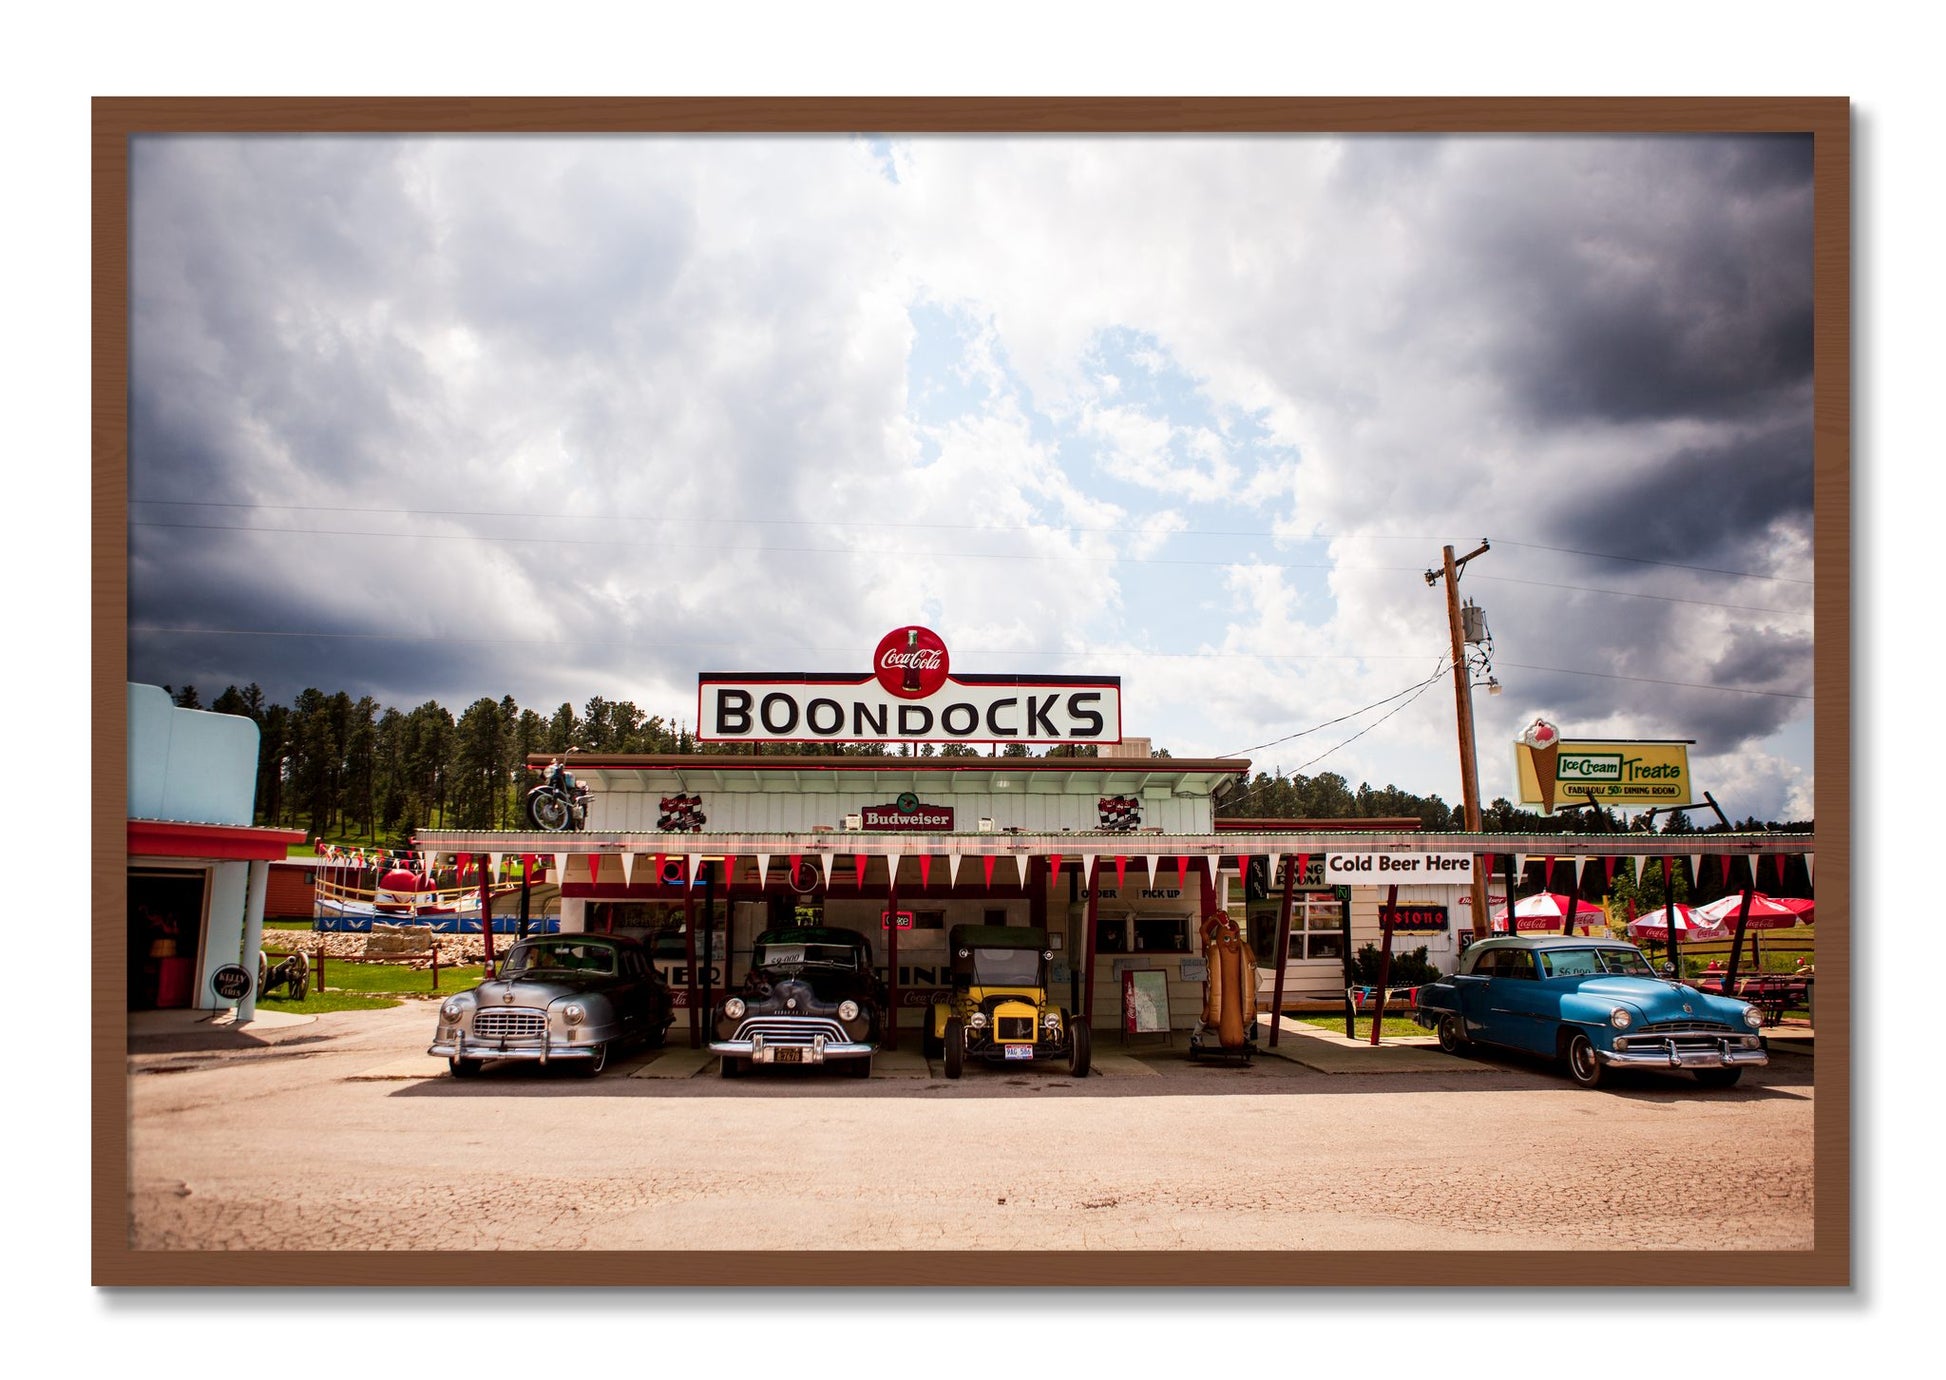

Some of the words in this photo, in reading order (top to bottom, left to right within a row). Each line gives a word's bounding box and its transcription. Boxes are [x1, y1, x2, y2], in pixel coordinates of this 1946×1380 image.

[881, 648, 943, 669] Coca-Cola
[717, 688, 1104, 737] BOONDOCKS
[1562, 759, 1579, 773] Ice
[1580, 759, 1617, 775] Cream
[1624, 758, 1681, 781] Treats
[1568, 786, 1606, 795] FABULOUS
[1624, 786, 1650, 795] DINING
[1652, 786, 1676, 795] ROOM
[866, 812, 950, 825] Budweiser
[1330, 855, 1372, 871] Cold
[1379, 855, 1420, 871] Beer
[1426, 855, 1470, 871] Here
[1081, 889, 1117, 898] ODER
[1142, 889, 1165, 899] PICK
[1167, 889, 1181, 899] UP
